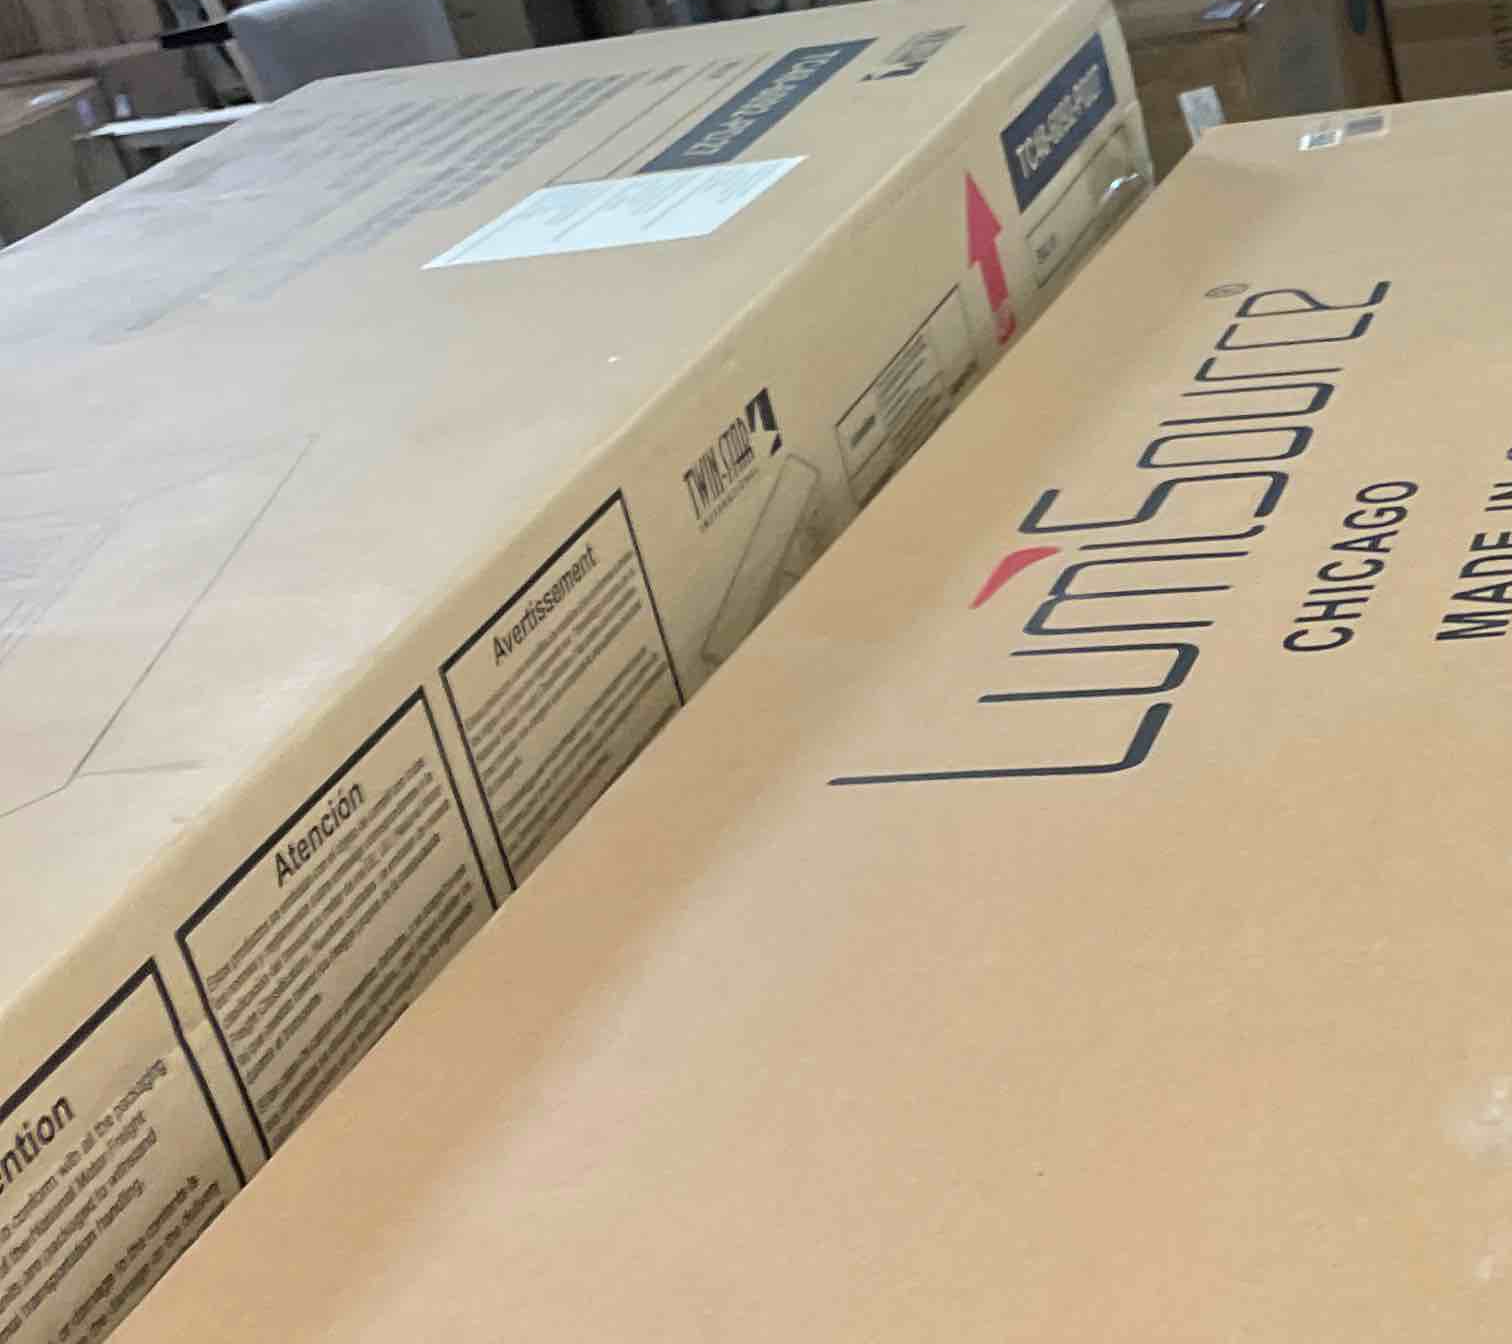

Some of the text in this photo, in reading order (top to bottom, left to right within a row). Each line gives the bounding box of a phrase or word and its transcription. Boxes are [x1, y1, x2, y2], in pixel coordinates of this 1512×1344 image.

[491, 542, 598, 665] Avertissement
[1283, 480, 1419, 653] CHICAGO
[273, 779, 366, 887] Atención
